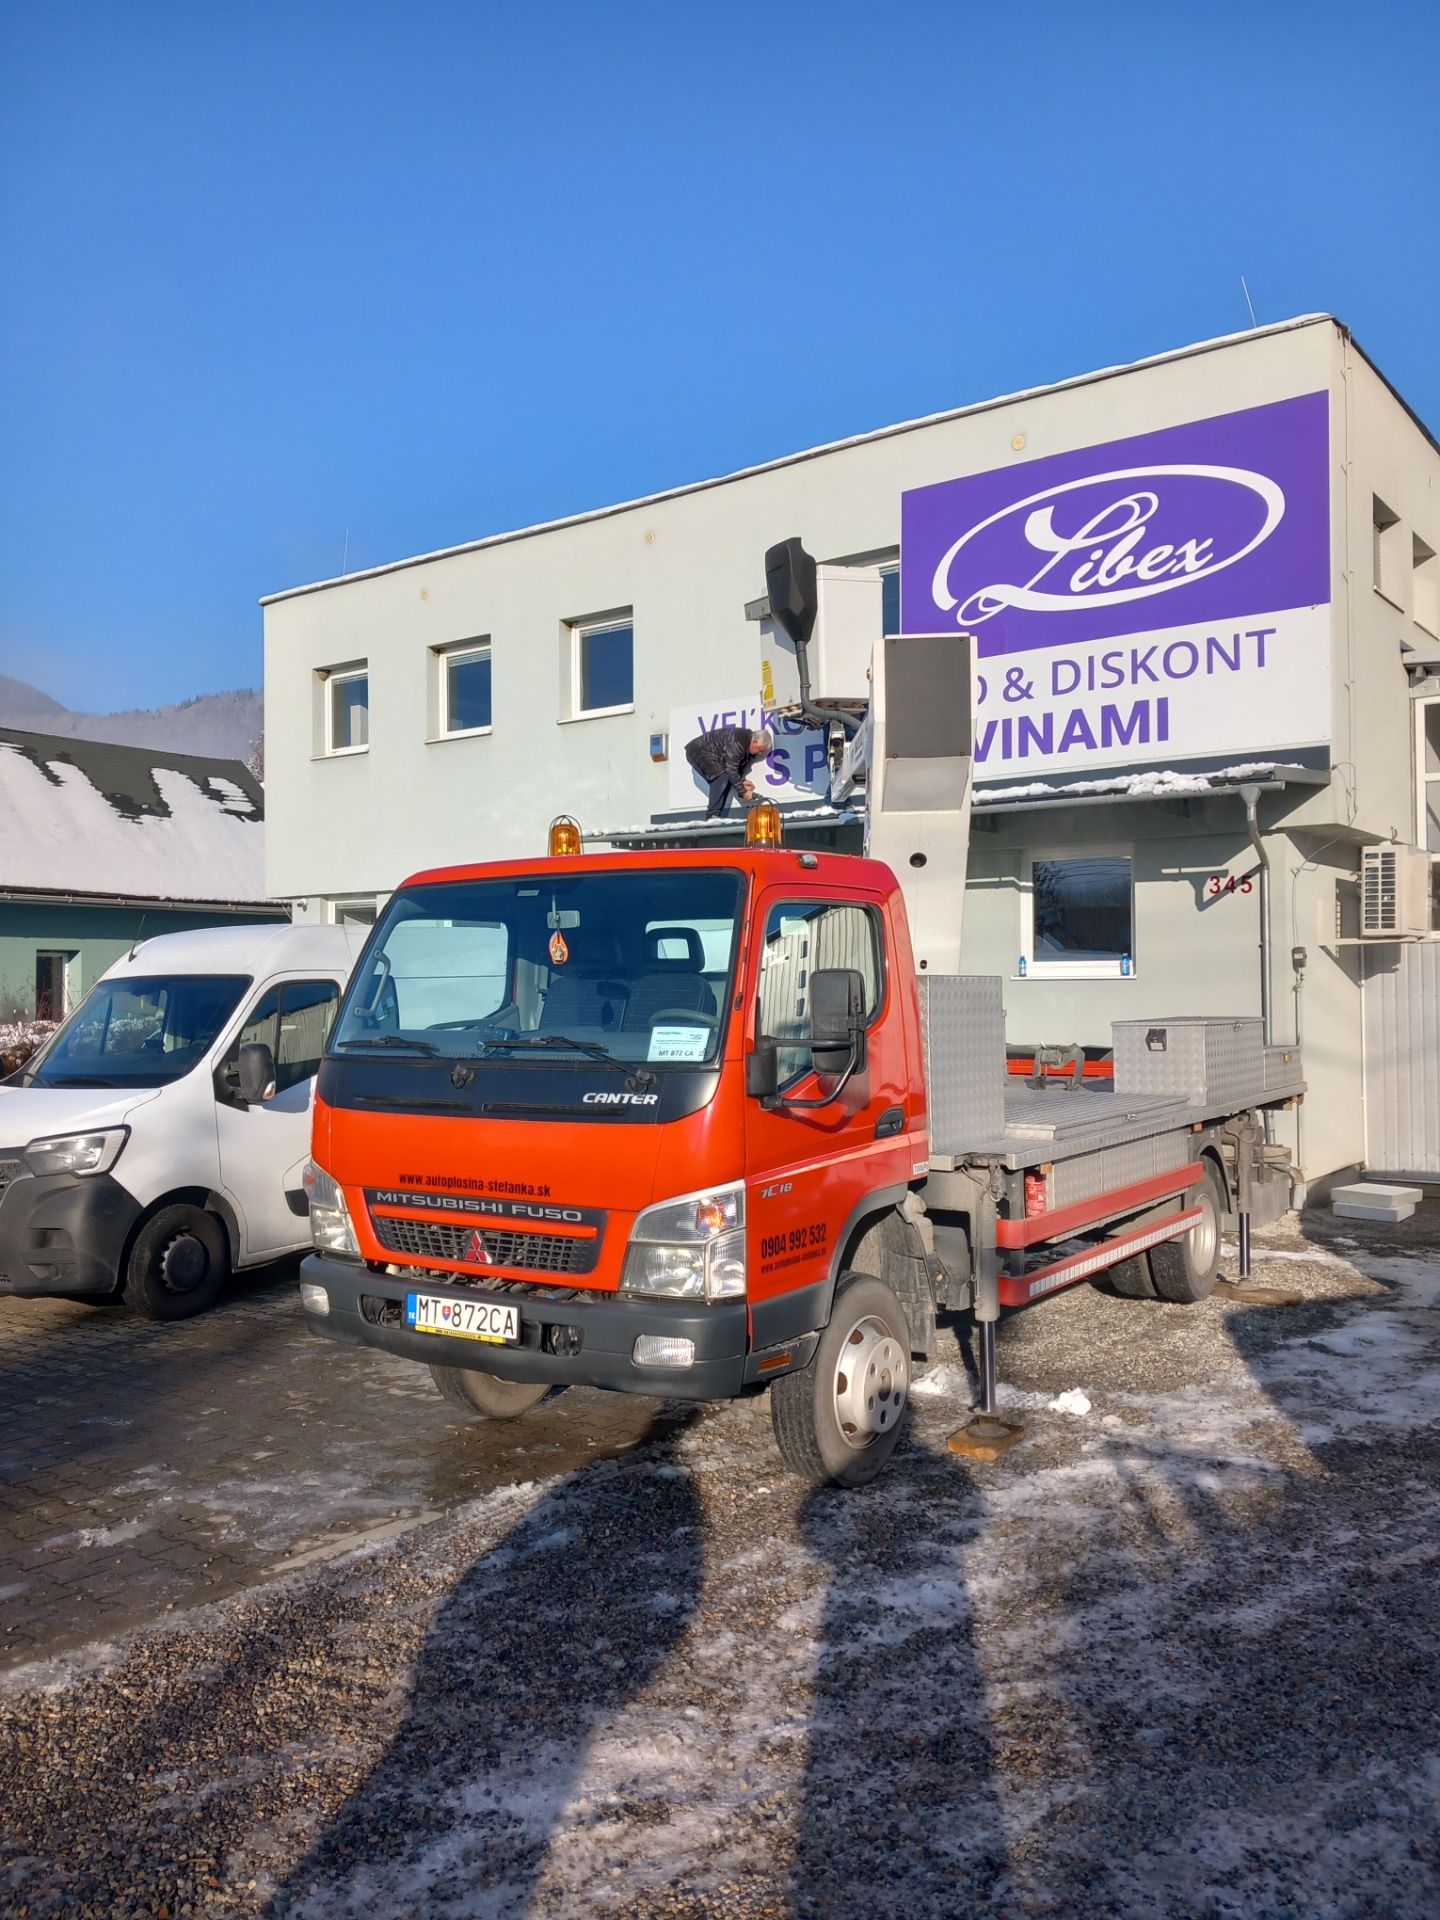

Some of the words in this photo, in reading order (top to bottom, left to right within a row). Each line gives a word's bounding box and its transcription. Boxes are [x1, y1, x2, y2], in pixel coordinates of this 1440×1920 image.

[957, 491, 1214, 626] Libex
[1003, 666, 1034, 702] &
[1051, 627, 1276, 697] DISKONT
[765, 748, 791, 786] S
[1209, 875, 1253, 894] 345
[582, 1092, 659, 1105] CANTER
[399, 1173, 551, 1198] www.autoplosina-stefanka.sk
[376, 1191, 504, 1214] MITSUBISHI
[511, 1204, 582, 1222] FUSO
[761, 1233, 787, 1260] 0904
[789, 1227, 808, 1252] 992
[809, 1222, 827, 1246] 532
[418, 1298, 441, 1325] MT
[451, 1302, 514, 1336] 872CA
